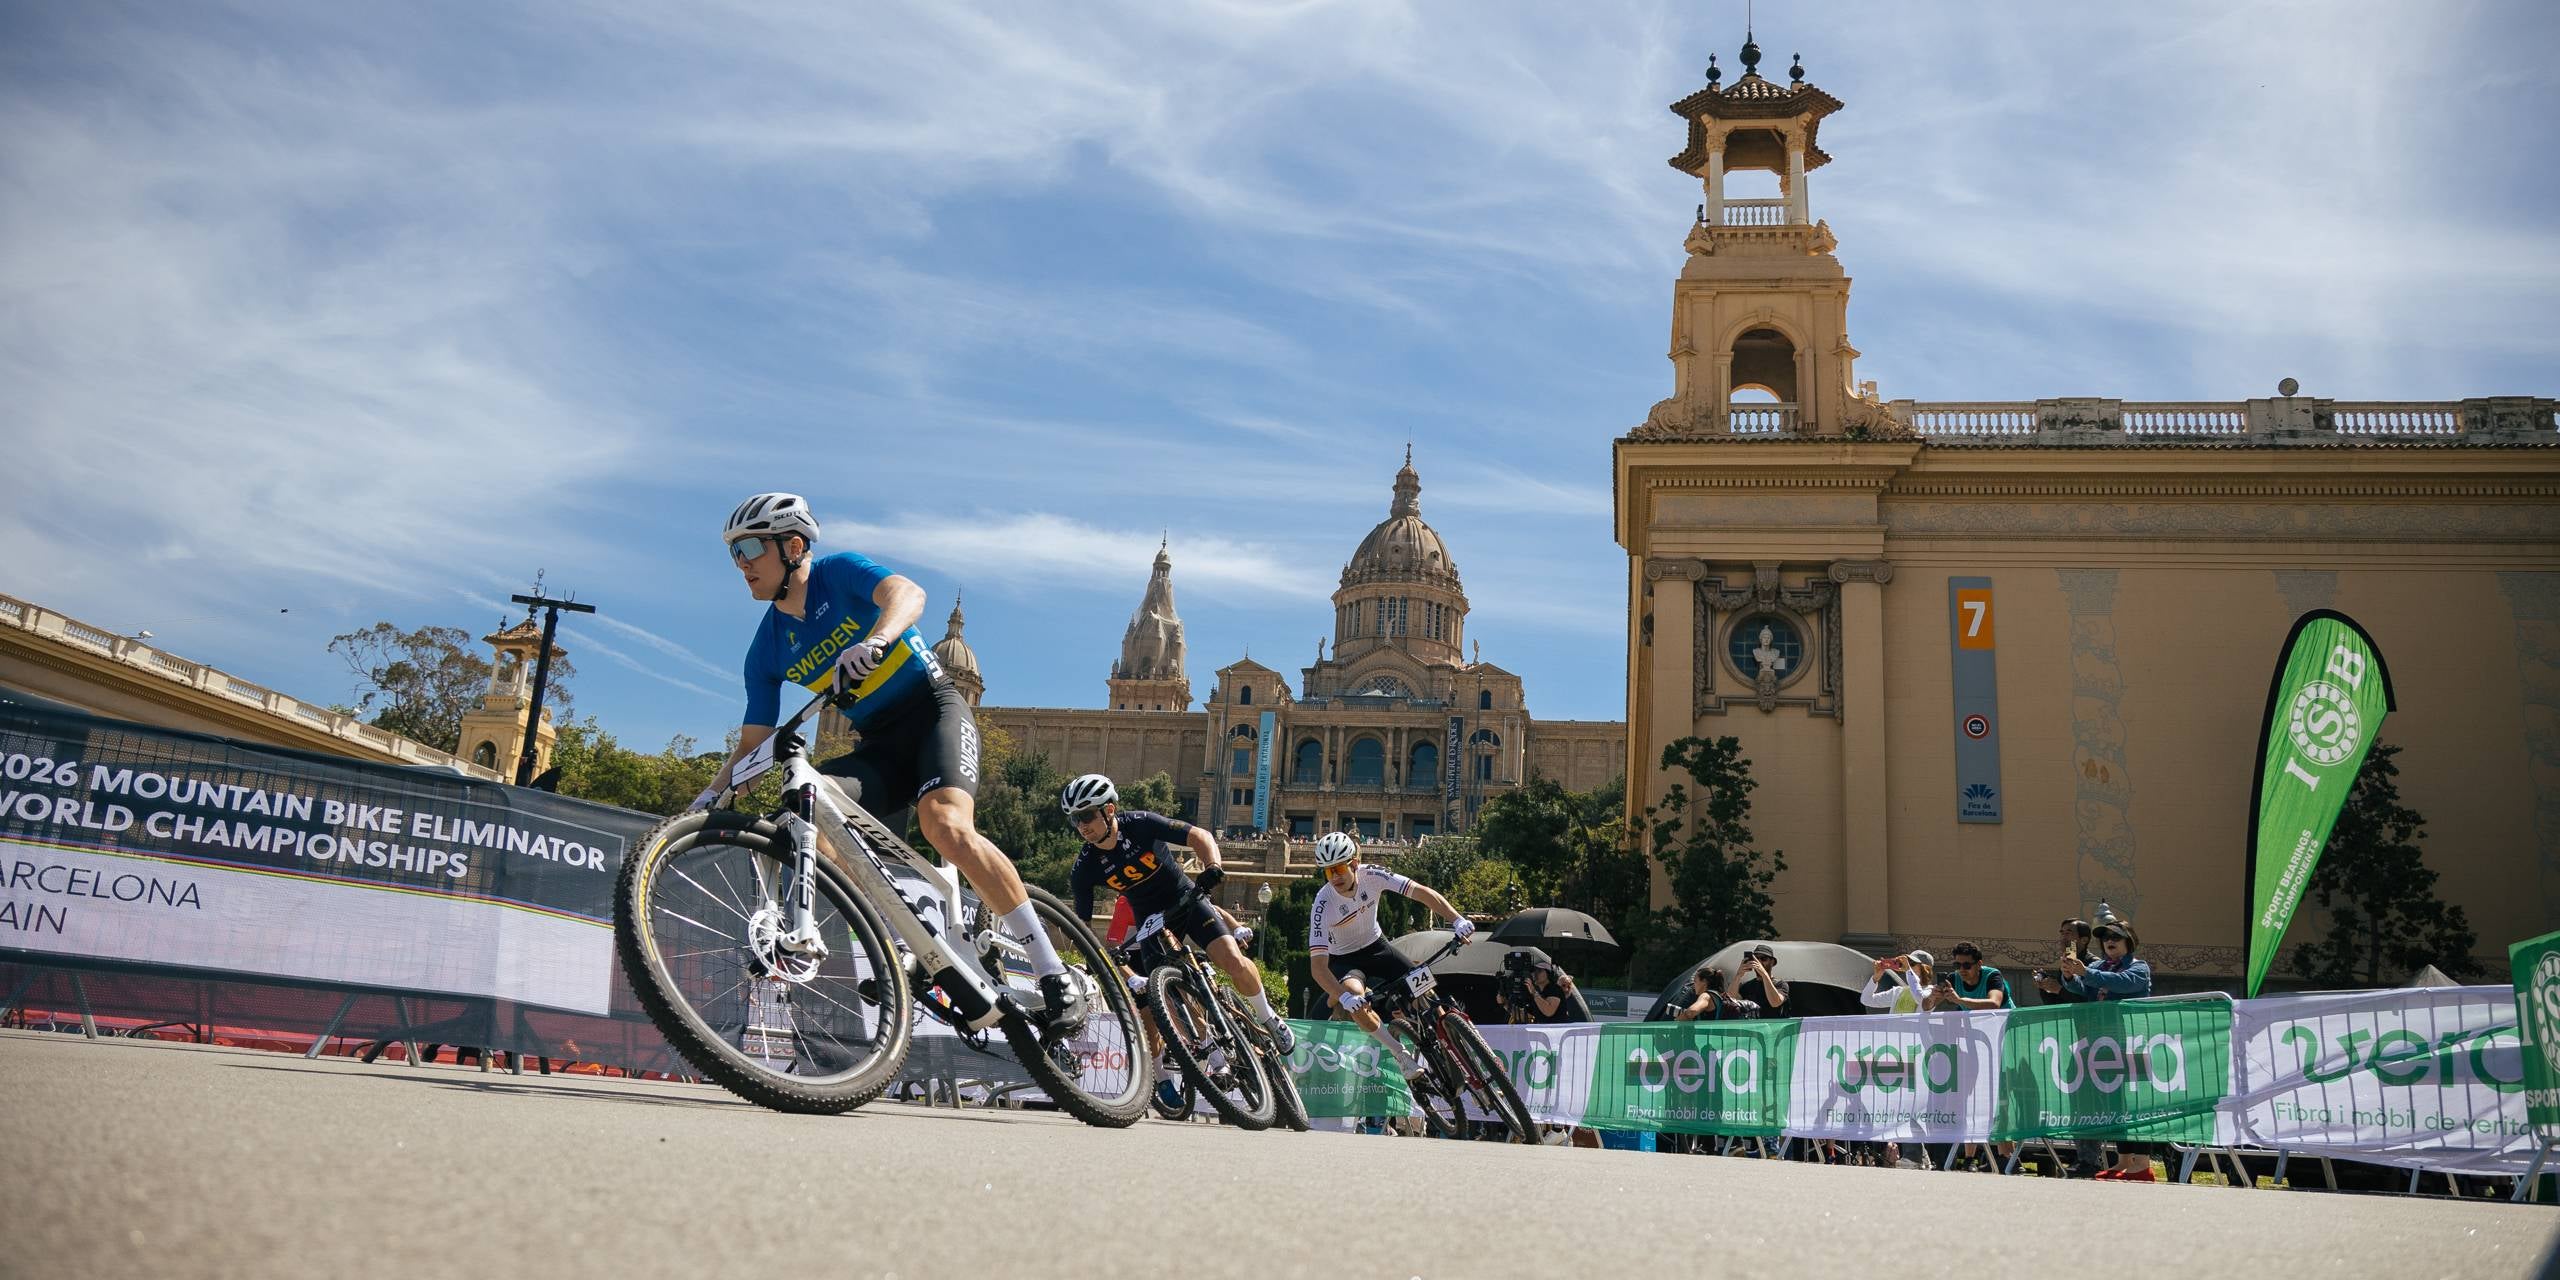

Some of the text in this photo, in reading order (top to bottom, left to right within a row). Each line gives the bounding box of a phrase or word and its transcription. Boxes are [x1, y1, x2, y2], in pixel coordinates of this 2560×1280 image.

[1963, 601, 1986, 636] 7
[786, 616, 861, 682] SWEDEN
[2284, 644, 2367, 792] ISB
[959, 717, 978, 783] SWEDEN
[1260, 763, 1268, 771] DE
[1261, 730, 1270, 763] CATALUNYA
[0, 752, 606, 872] 026 MOUNTAIN BIKE ELIMINATOR
[1257, 791, 1265, 820] NACIONAL
[146, 811, 469, 878] CHAMPIONSHIPS
[843, 812, 916, 860] SCOTT
[0, 860, 202, 909] RCELONA
[847, 825, 930, 923] SCOTT
[2262, 829, 2312, 928] SPORT BEARINGS
[2273, 839, 2319, 930] & COMPONENTS
[962, 904, 978, 926] 20
[1412, 971, 1430, 988] 24
[1628, 1047, 1758, 1095] vera
[1825, 1043, 1959, 1094] vera
[2038, 1033, 2187, 1094] vera
[1341, 1083, 1354, 1094] de
[1358, 1082, 1388, 1095] veritat
[1627, 1105, 1656, 1119] Fibra
[1658, 1105, 1662, 1118] i
[1700, 1107, 1716, 1120] de
[1719, 1107, 1758, 1122] veritat
[1826, 1109, 1855, 1123] Fibra
[1857, 1109, 1862, 1123] i
[1896, 1109, 1911, 1123] de
[1913, 1110, 1957, 1124] veritat
[2038, 1110, 2071, 1127] Fibra
[2072, 1112, 2077, 1126] i
[2115, 1111, 2133, 1124] de
[2275, 1102, 2532, 1137] Fibra i mòbil de verita
